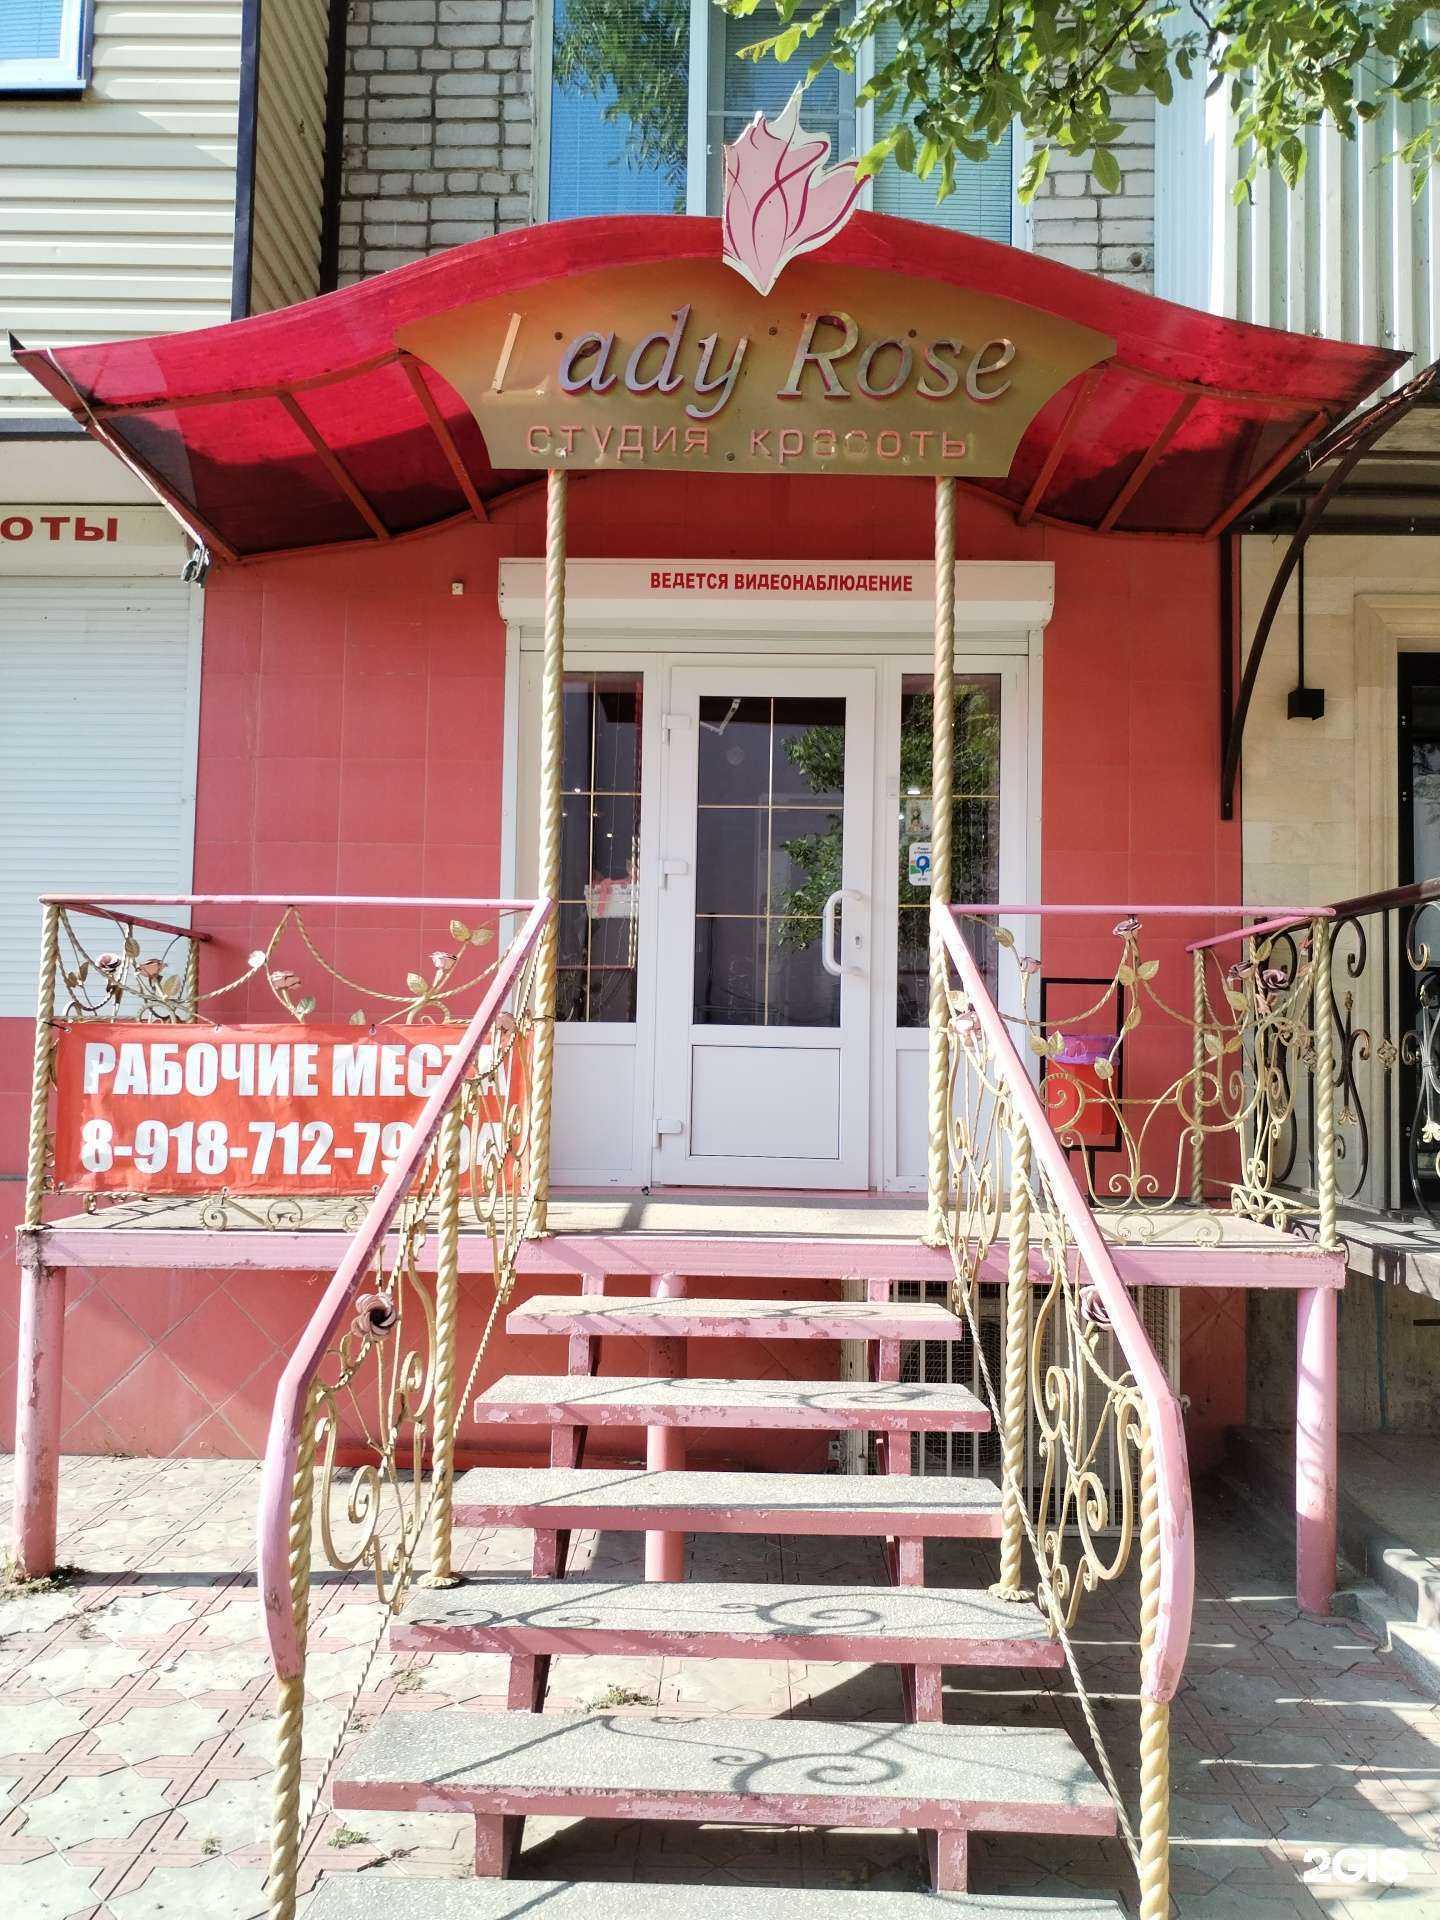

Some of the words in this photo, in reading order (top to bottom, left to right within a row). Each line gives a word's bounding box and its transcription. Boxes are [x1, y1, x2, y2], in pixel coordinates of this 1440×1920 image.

[486, 303, 750, 420] Lady
[776, 311, 1018, 402] Rose
[0, 516, 119, 542] ОТЫ
[650, 572, 729, 590] ВЕДЕТСЯ
[734, 573, 913, 592] ВИДЕОНАБЛЮДЕНИЕ
[83, 1042, 319, 1097] РАБОЧИЕ
